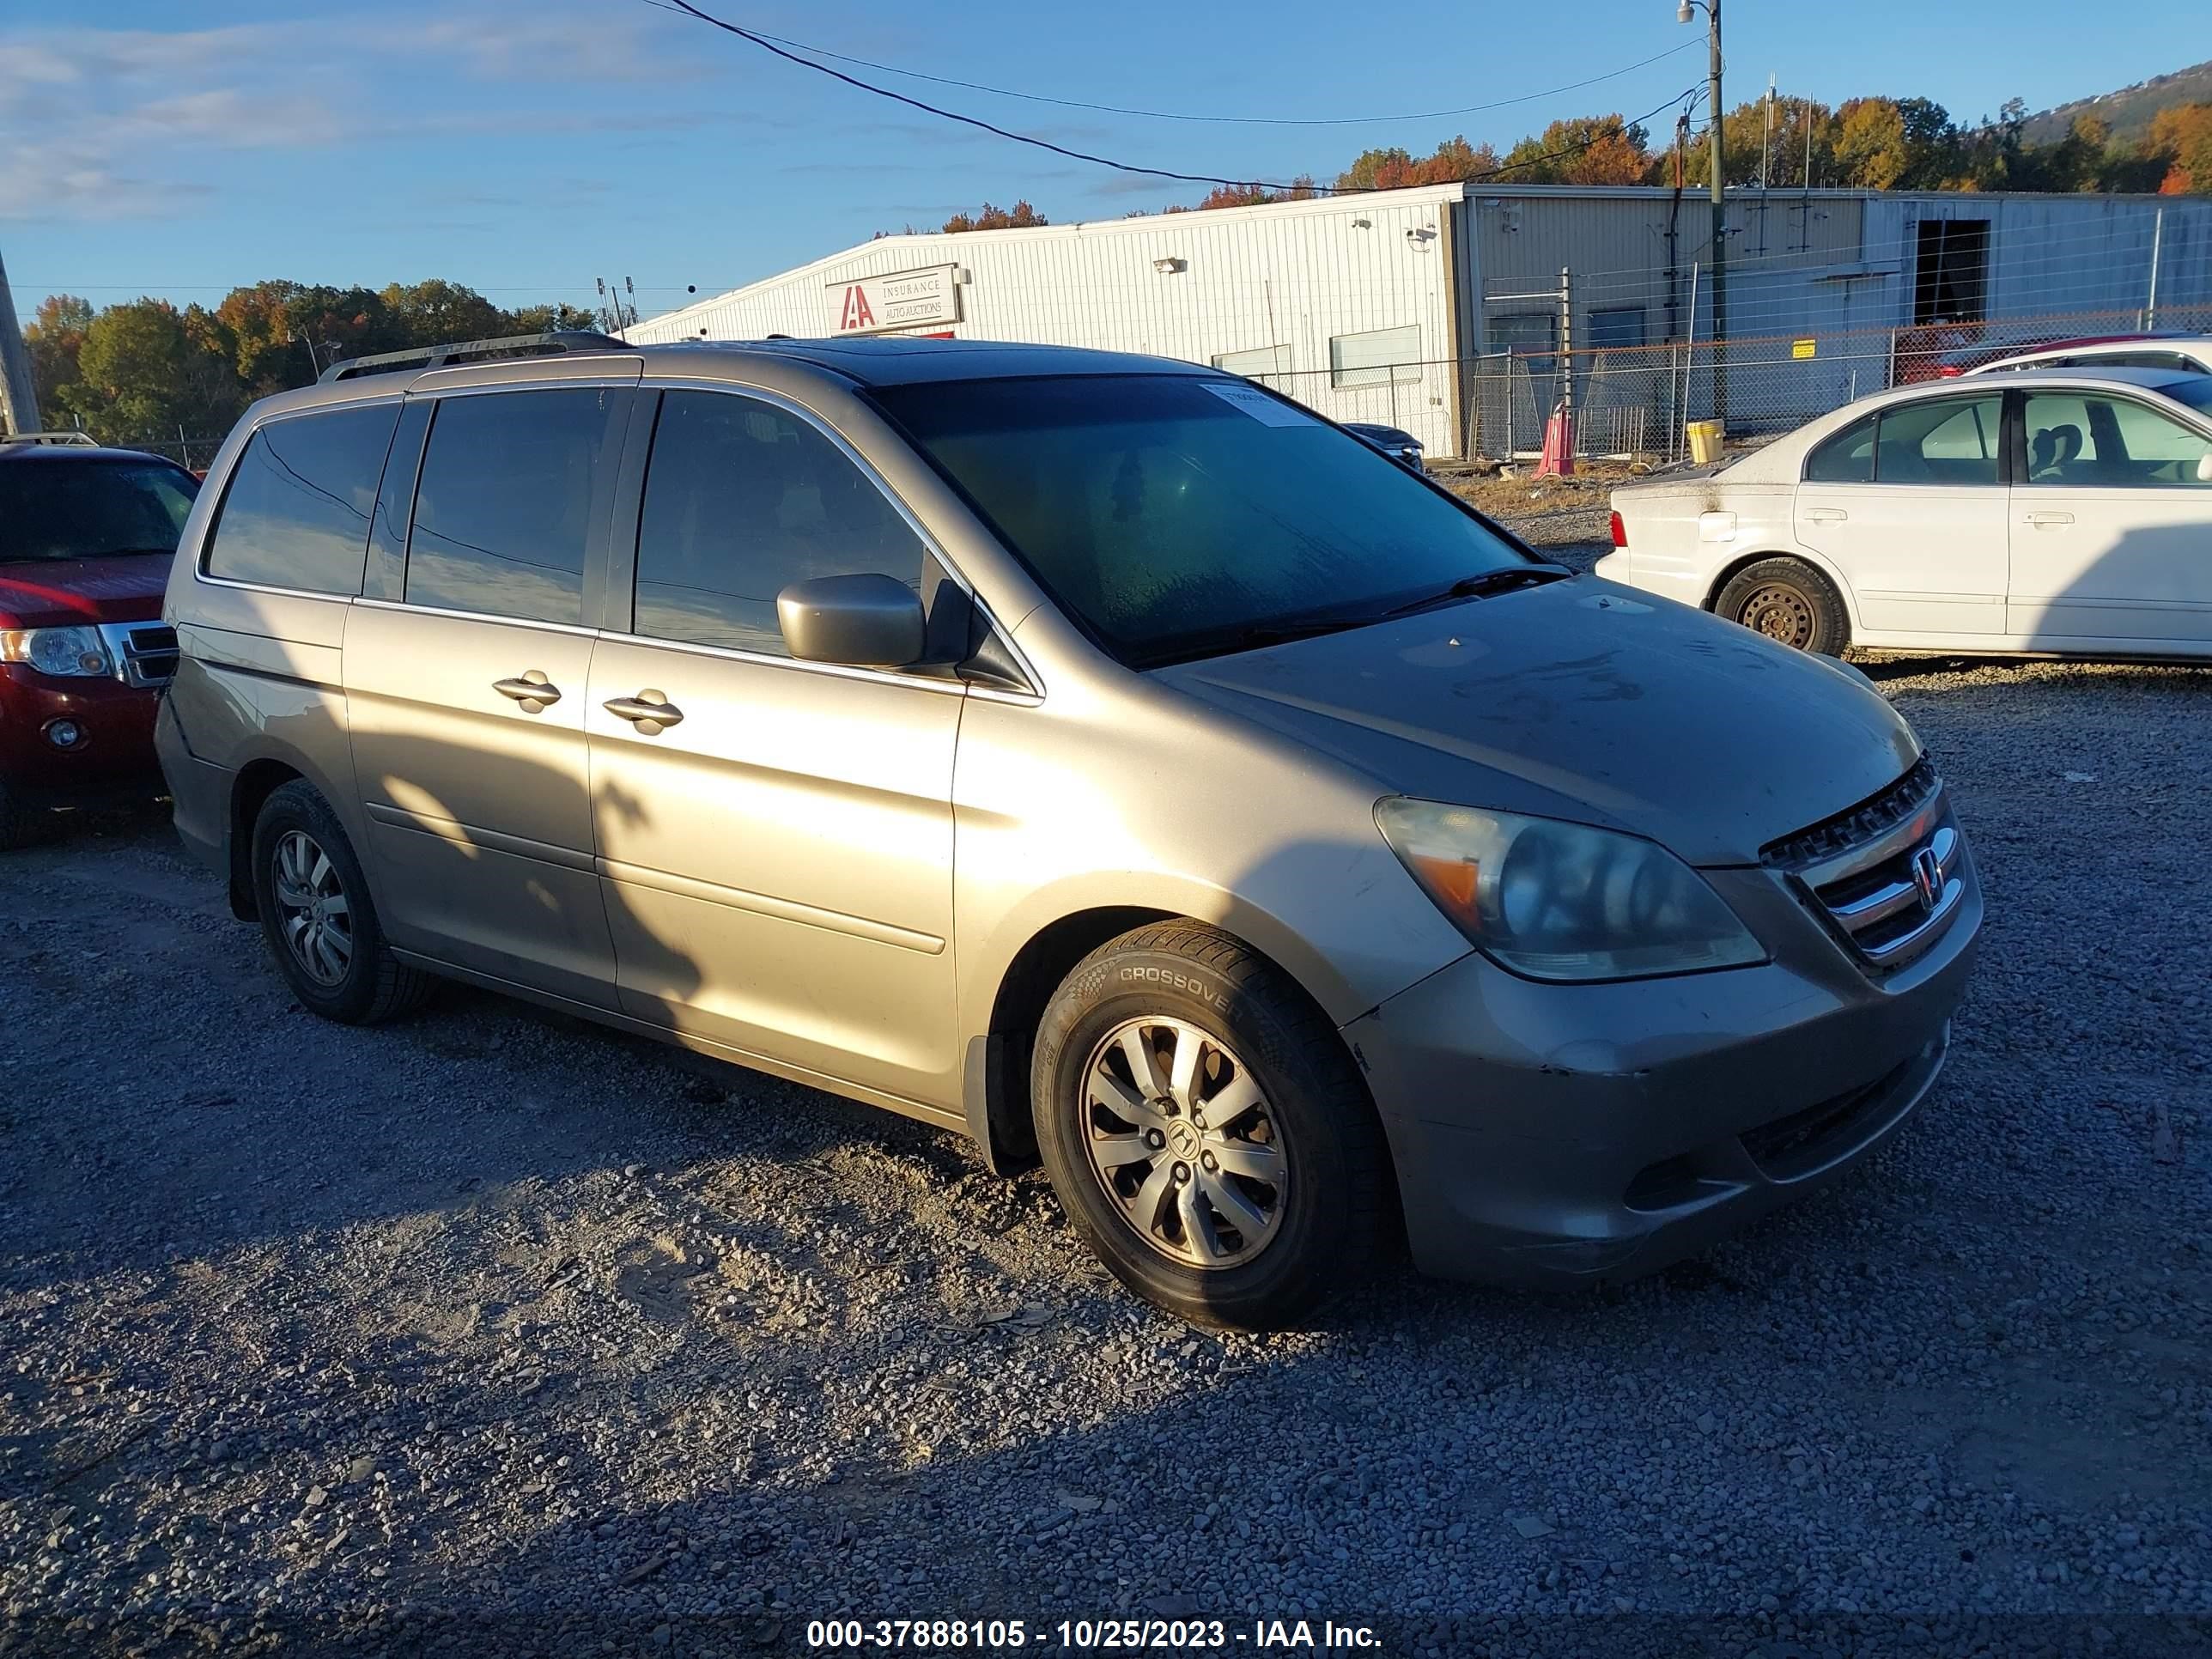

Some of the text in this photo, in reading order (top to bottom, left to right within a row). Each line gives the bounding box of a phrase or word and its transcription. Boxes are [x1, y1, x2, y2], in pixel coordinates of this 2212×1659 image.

[883, 280, 940, 298] INSURANCE
[886, 301, 942, 320] AUTO AUCTIONS
